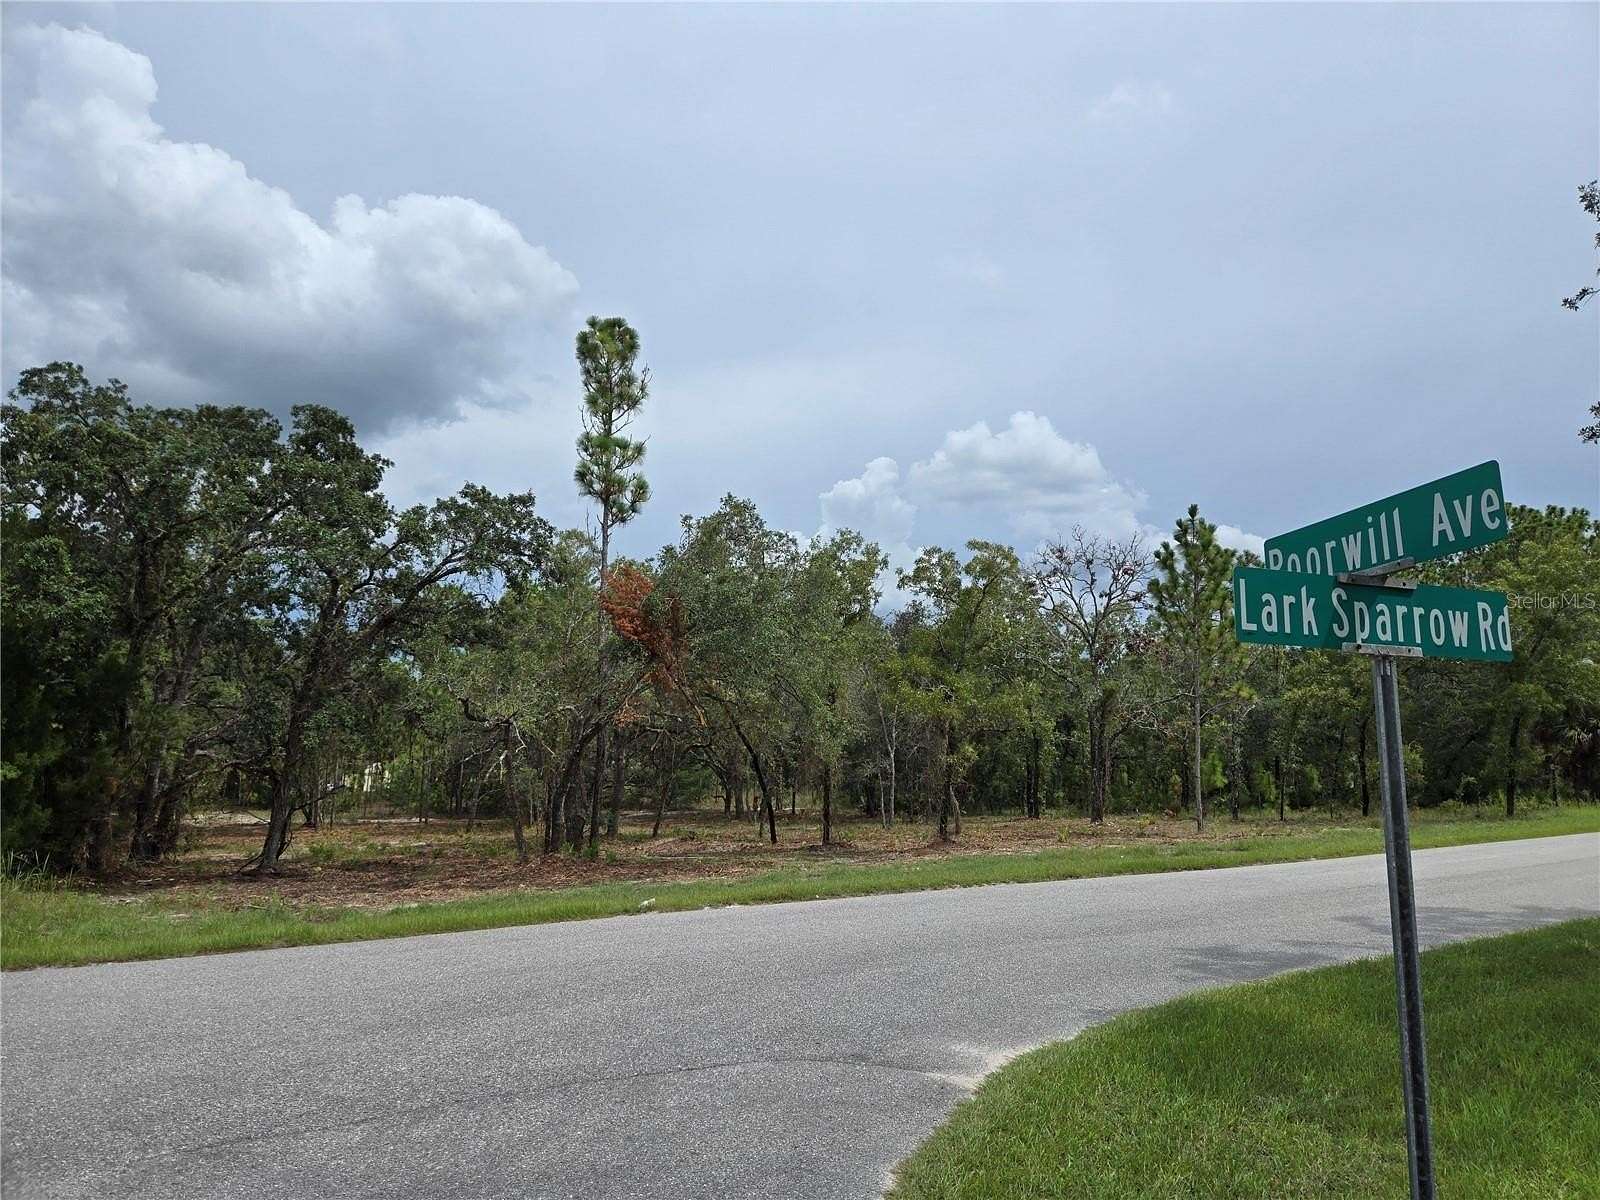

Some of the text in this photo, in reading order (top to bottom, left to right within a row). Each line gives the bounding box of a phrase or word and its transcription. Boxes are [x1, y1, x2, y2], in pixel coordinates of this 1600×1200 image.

[1432, 488, 1501, 547] Ave
[1239, 578, 1512, 653] Lark Sparrow Rd
